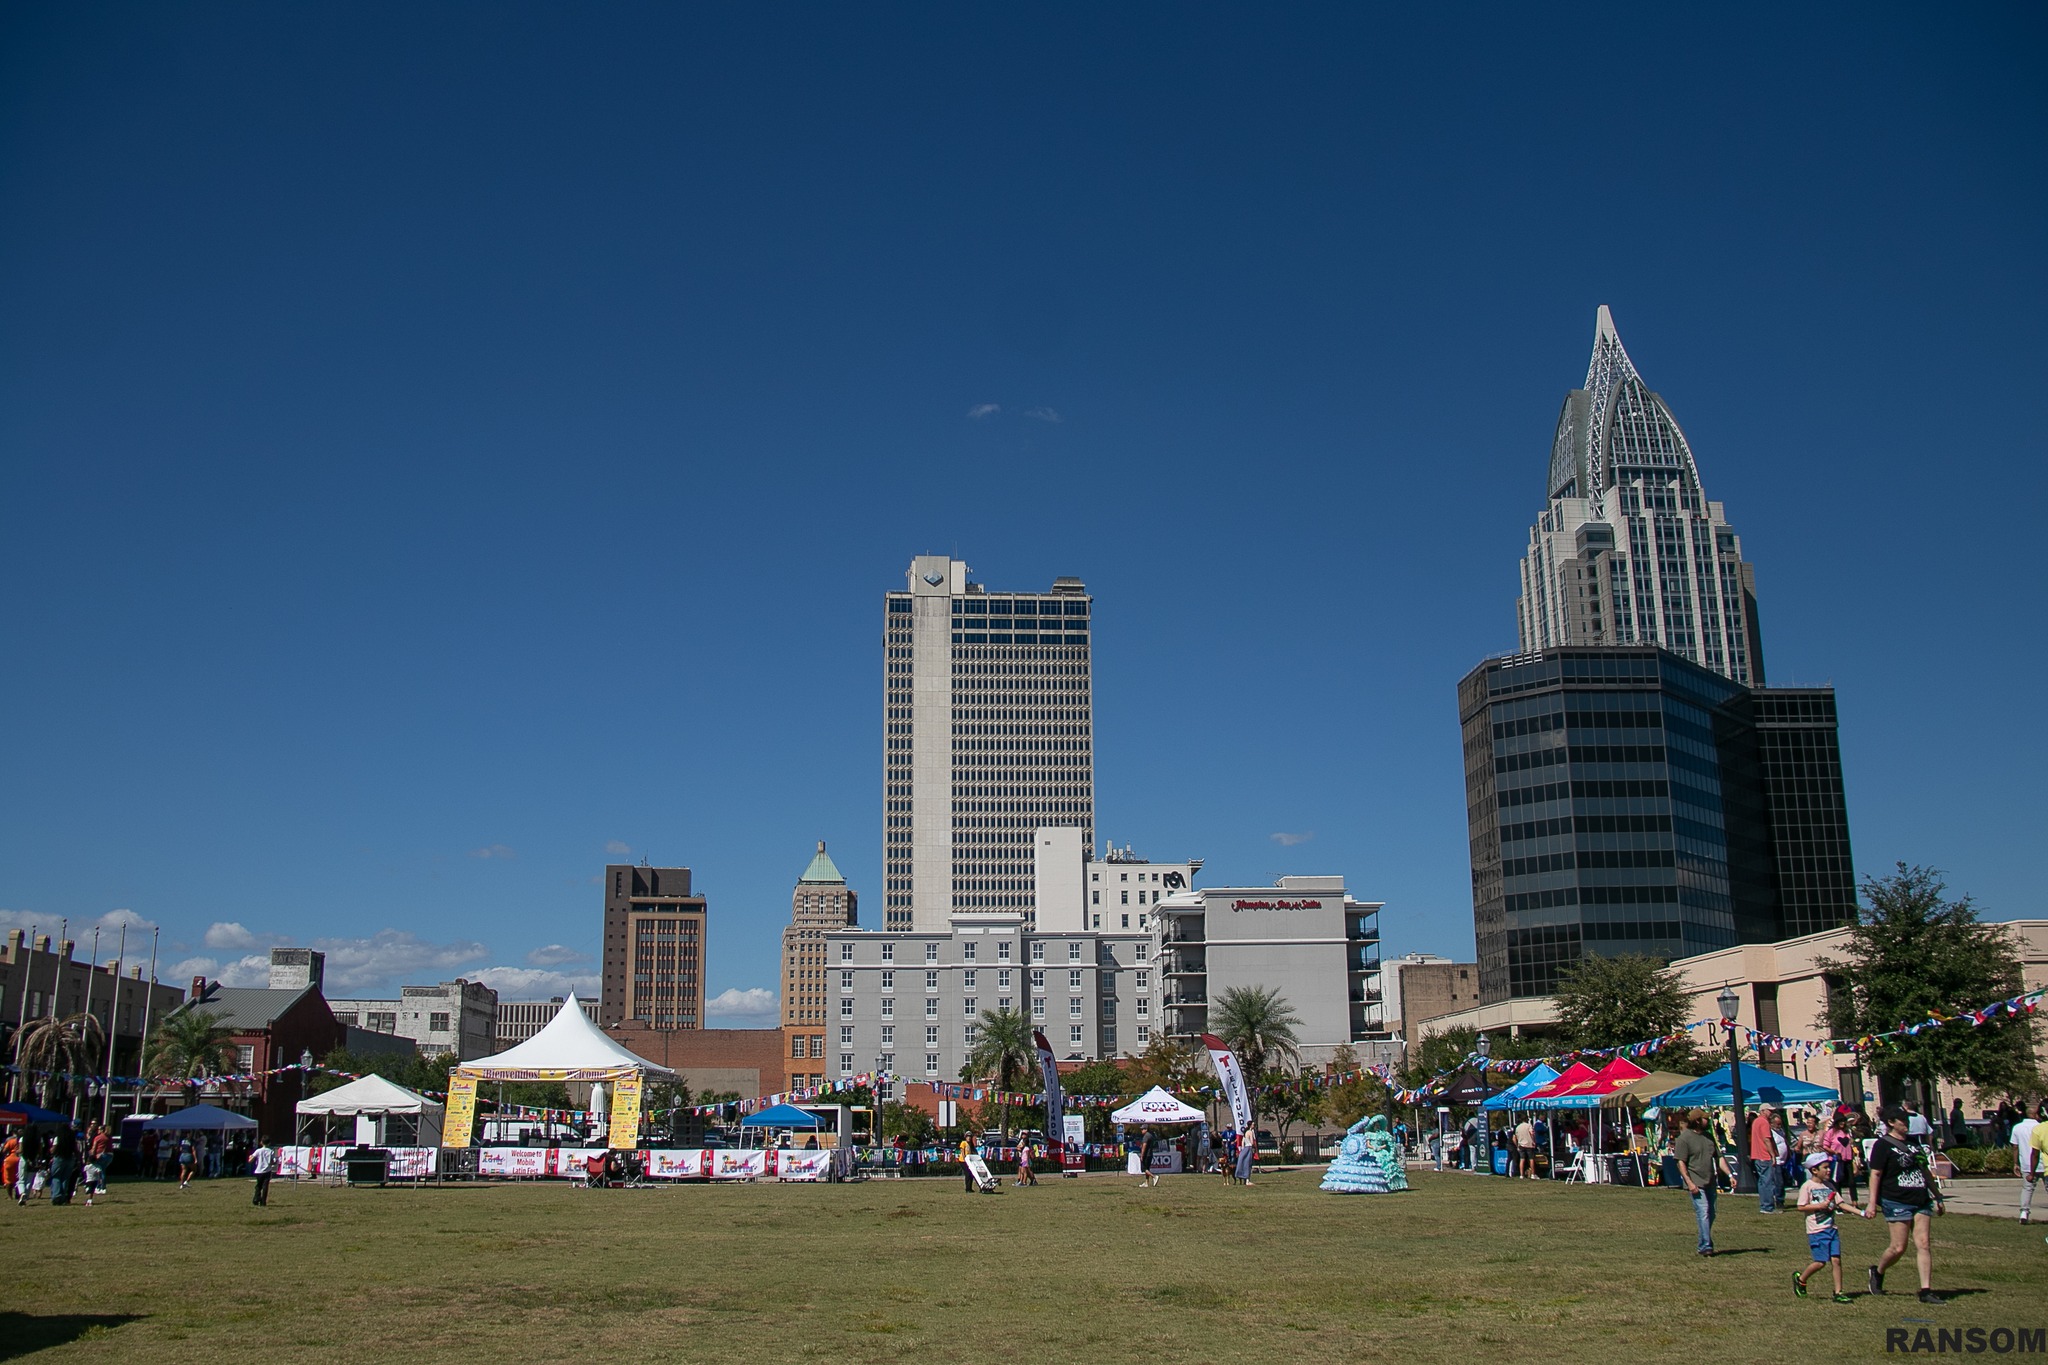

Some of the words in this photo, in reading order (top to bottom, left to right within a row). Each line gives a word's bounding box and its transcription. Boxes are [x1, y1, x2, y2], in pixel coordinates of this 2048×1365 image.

[1226, 1069, 1246, 1133] TELEMUNDO
[1142, 1102, 1178, 1111] FOX10
[511, 1150, 537, 1158] Welcome
[528, 1168, 539, 1176] Fest
